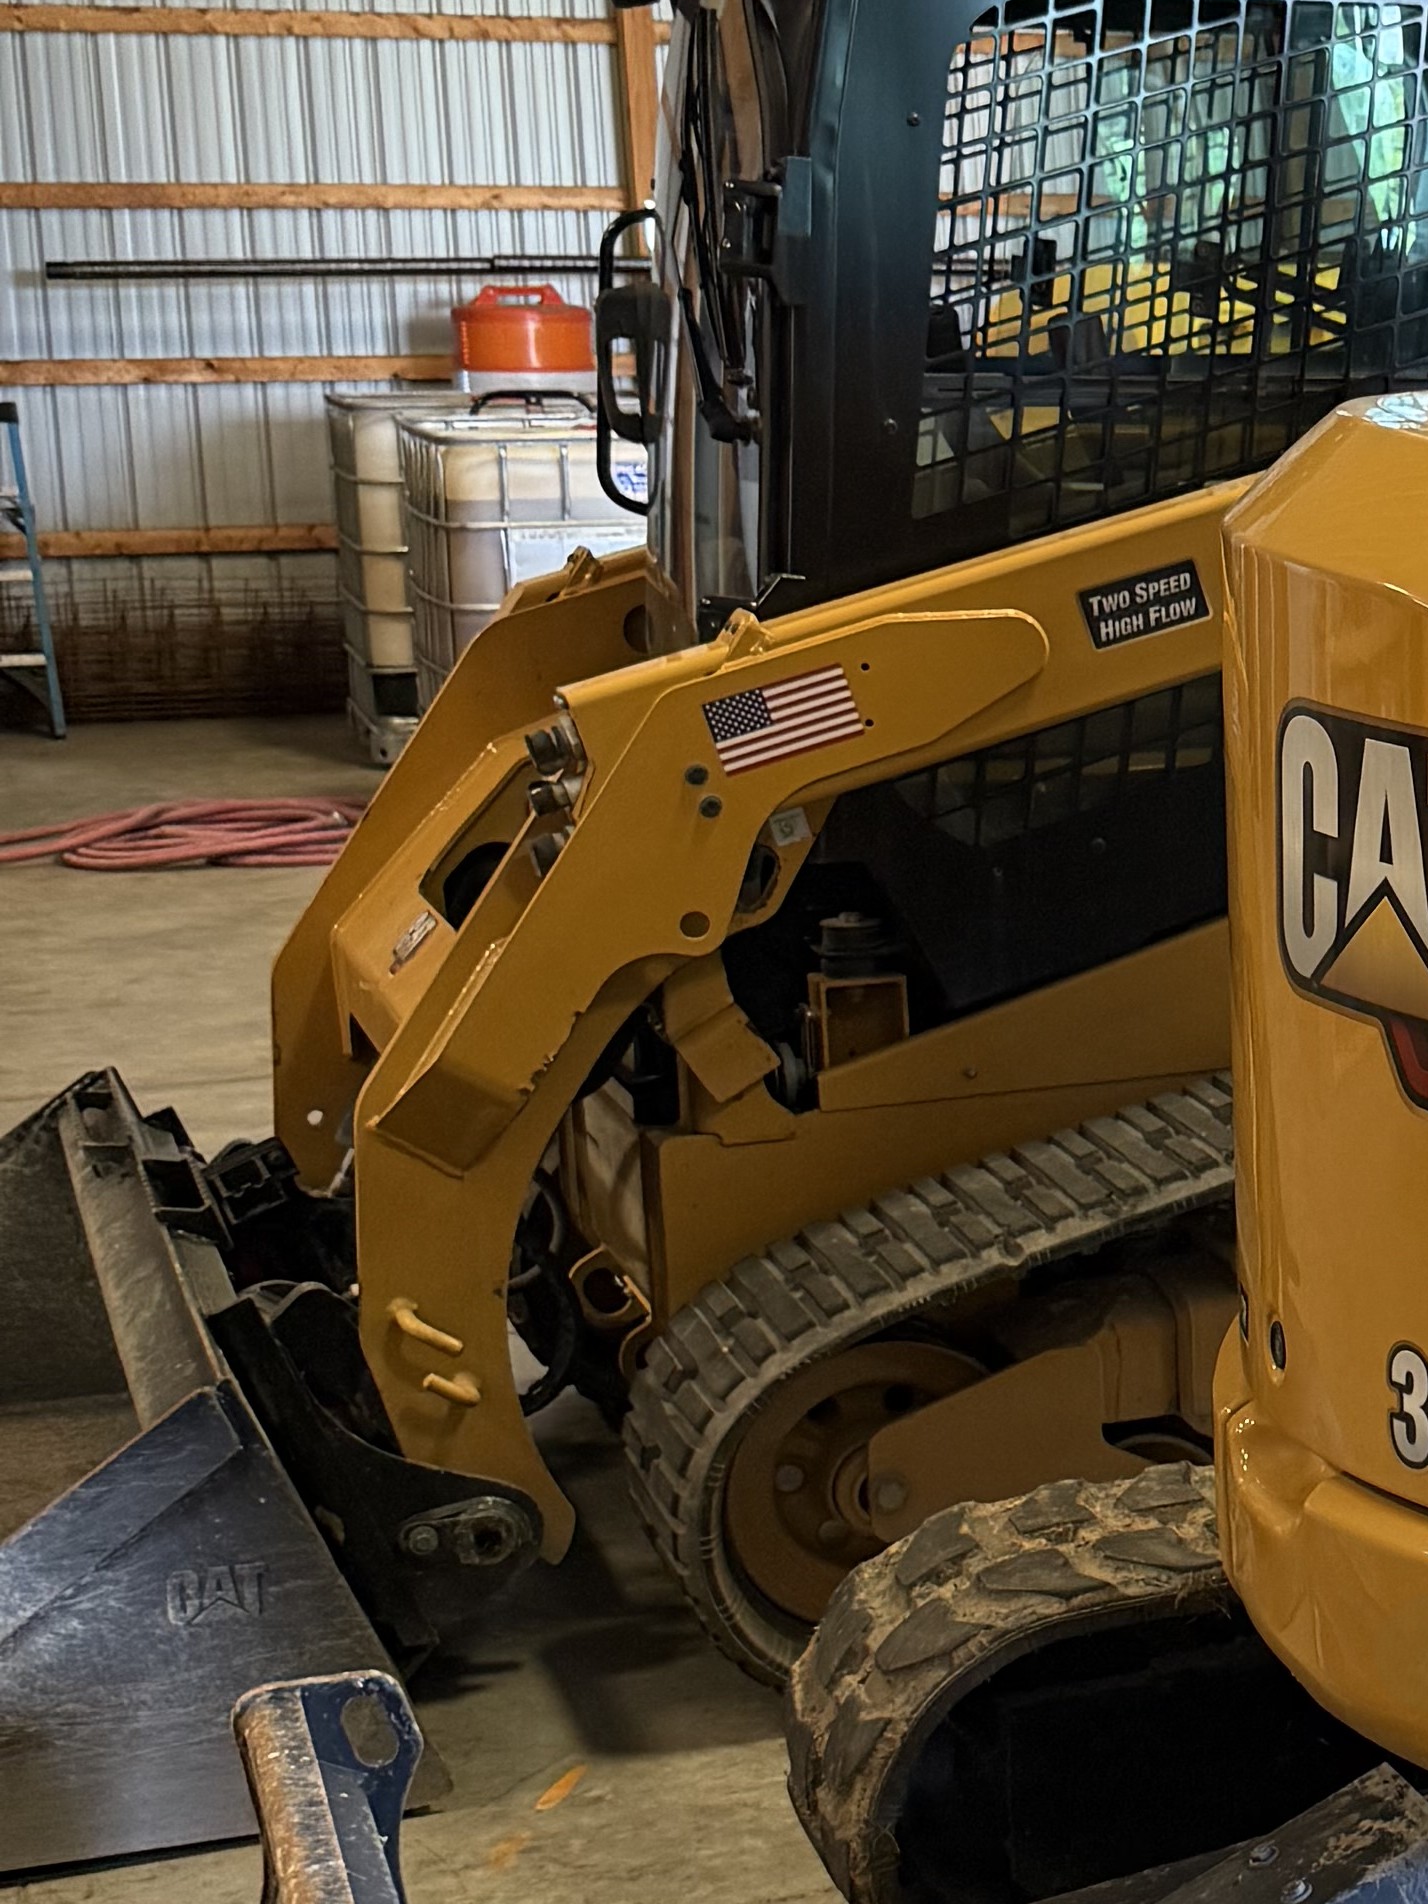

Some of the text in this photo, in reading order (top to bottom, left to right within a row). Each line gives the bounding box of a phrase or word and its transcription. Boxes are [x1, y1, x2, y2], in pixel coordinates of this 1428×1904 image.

[1088, 572, 1192, 617] TWO SPEED
[1099, 596, 1197, 642] HIGH FLOW
[166, 1561, 269, 1626] CAT
